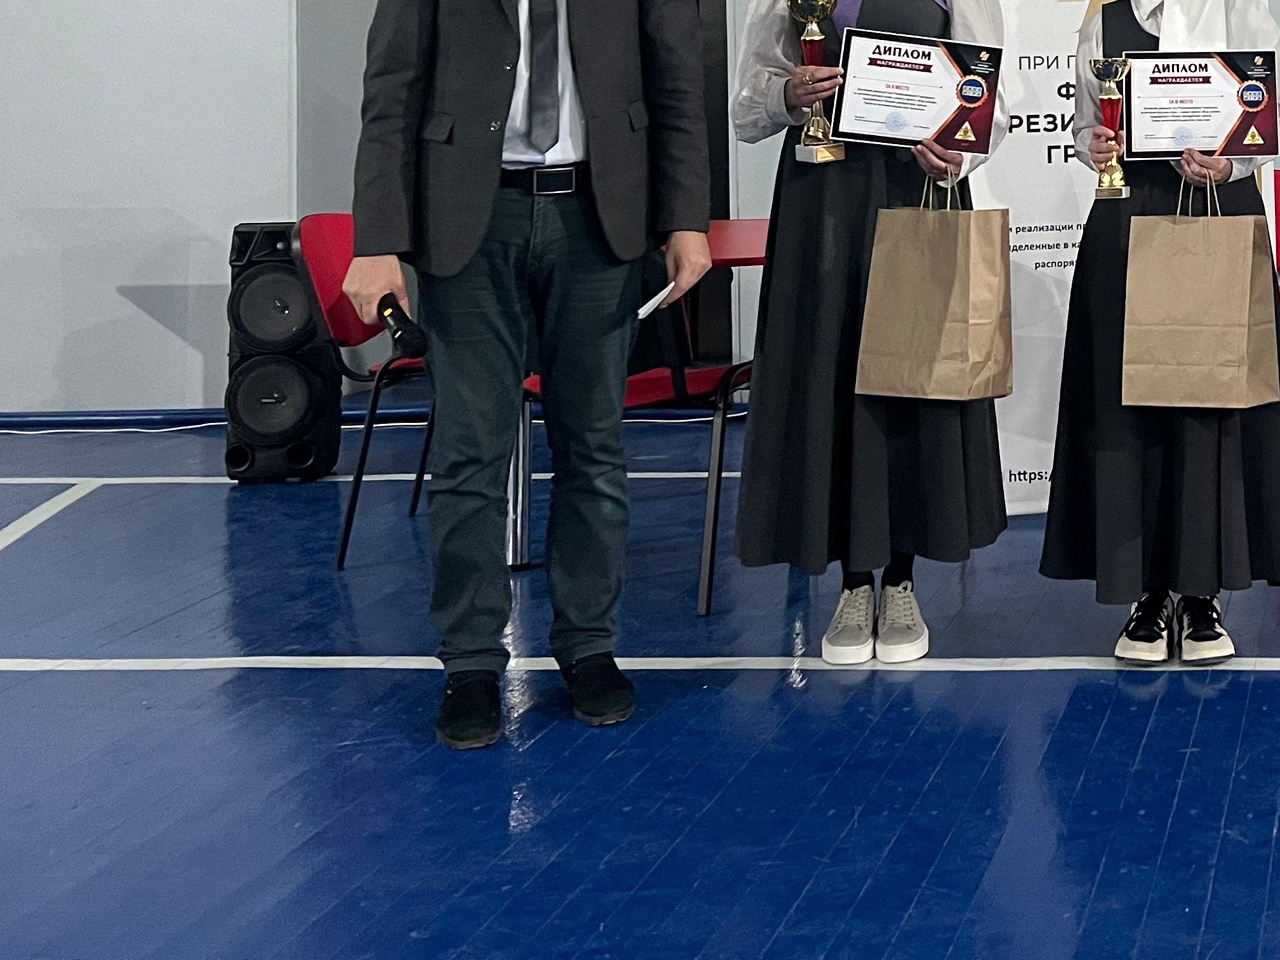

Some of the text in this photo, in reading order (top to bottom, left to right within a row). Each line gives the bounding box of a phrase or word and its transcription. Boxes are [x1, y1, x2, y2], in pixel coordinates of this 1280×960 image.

[872, 44, 931, 61] ДИПЛОМ
[1018, 55, 1059, 70] ПРИ
[1152, 63, 1208, 74] ДИПЛОМ
[1015, 224, 1074, 234] реализации
